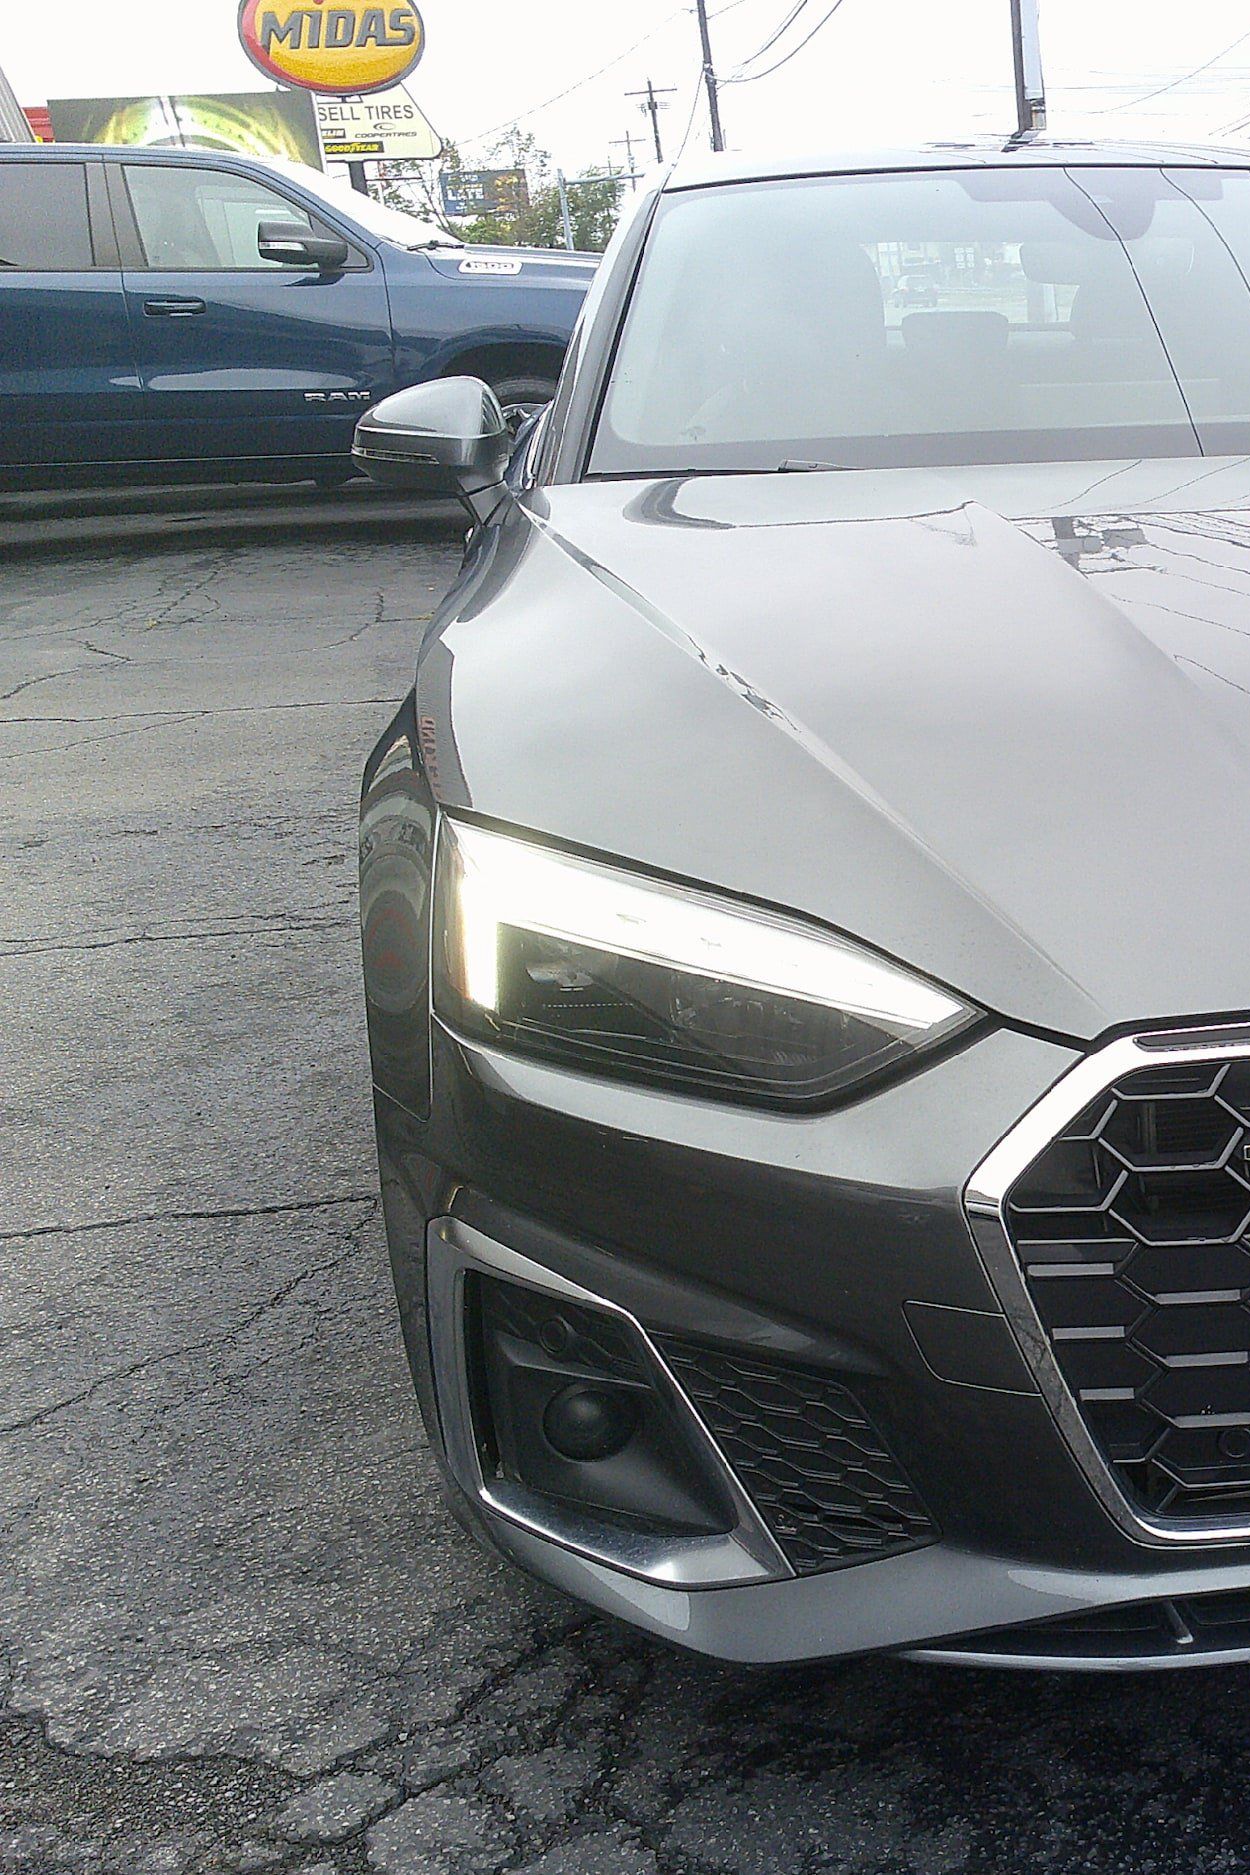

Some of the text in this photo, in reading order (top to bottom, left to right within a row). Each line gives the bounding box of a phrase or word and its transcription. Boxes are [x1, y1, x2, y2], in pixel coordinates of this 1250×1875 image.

[261, 8, 416, 53] MIDAS
[318, 105, 414, 121] SELL TIRES
[303, 391, 370, 402] RAM
